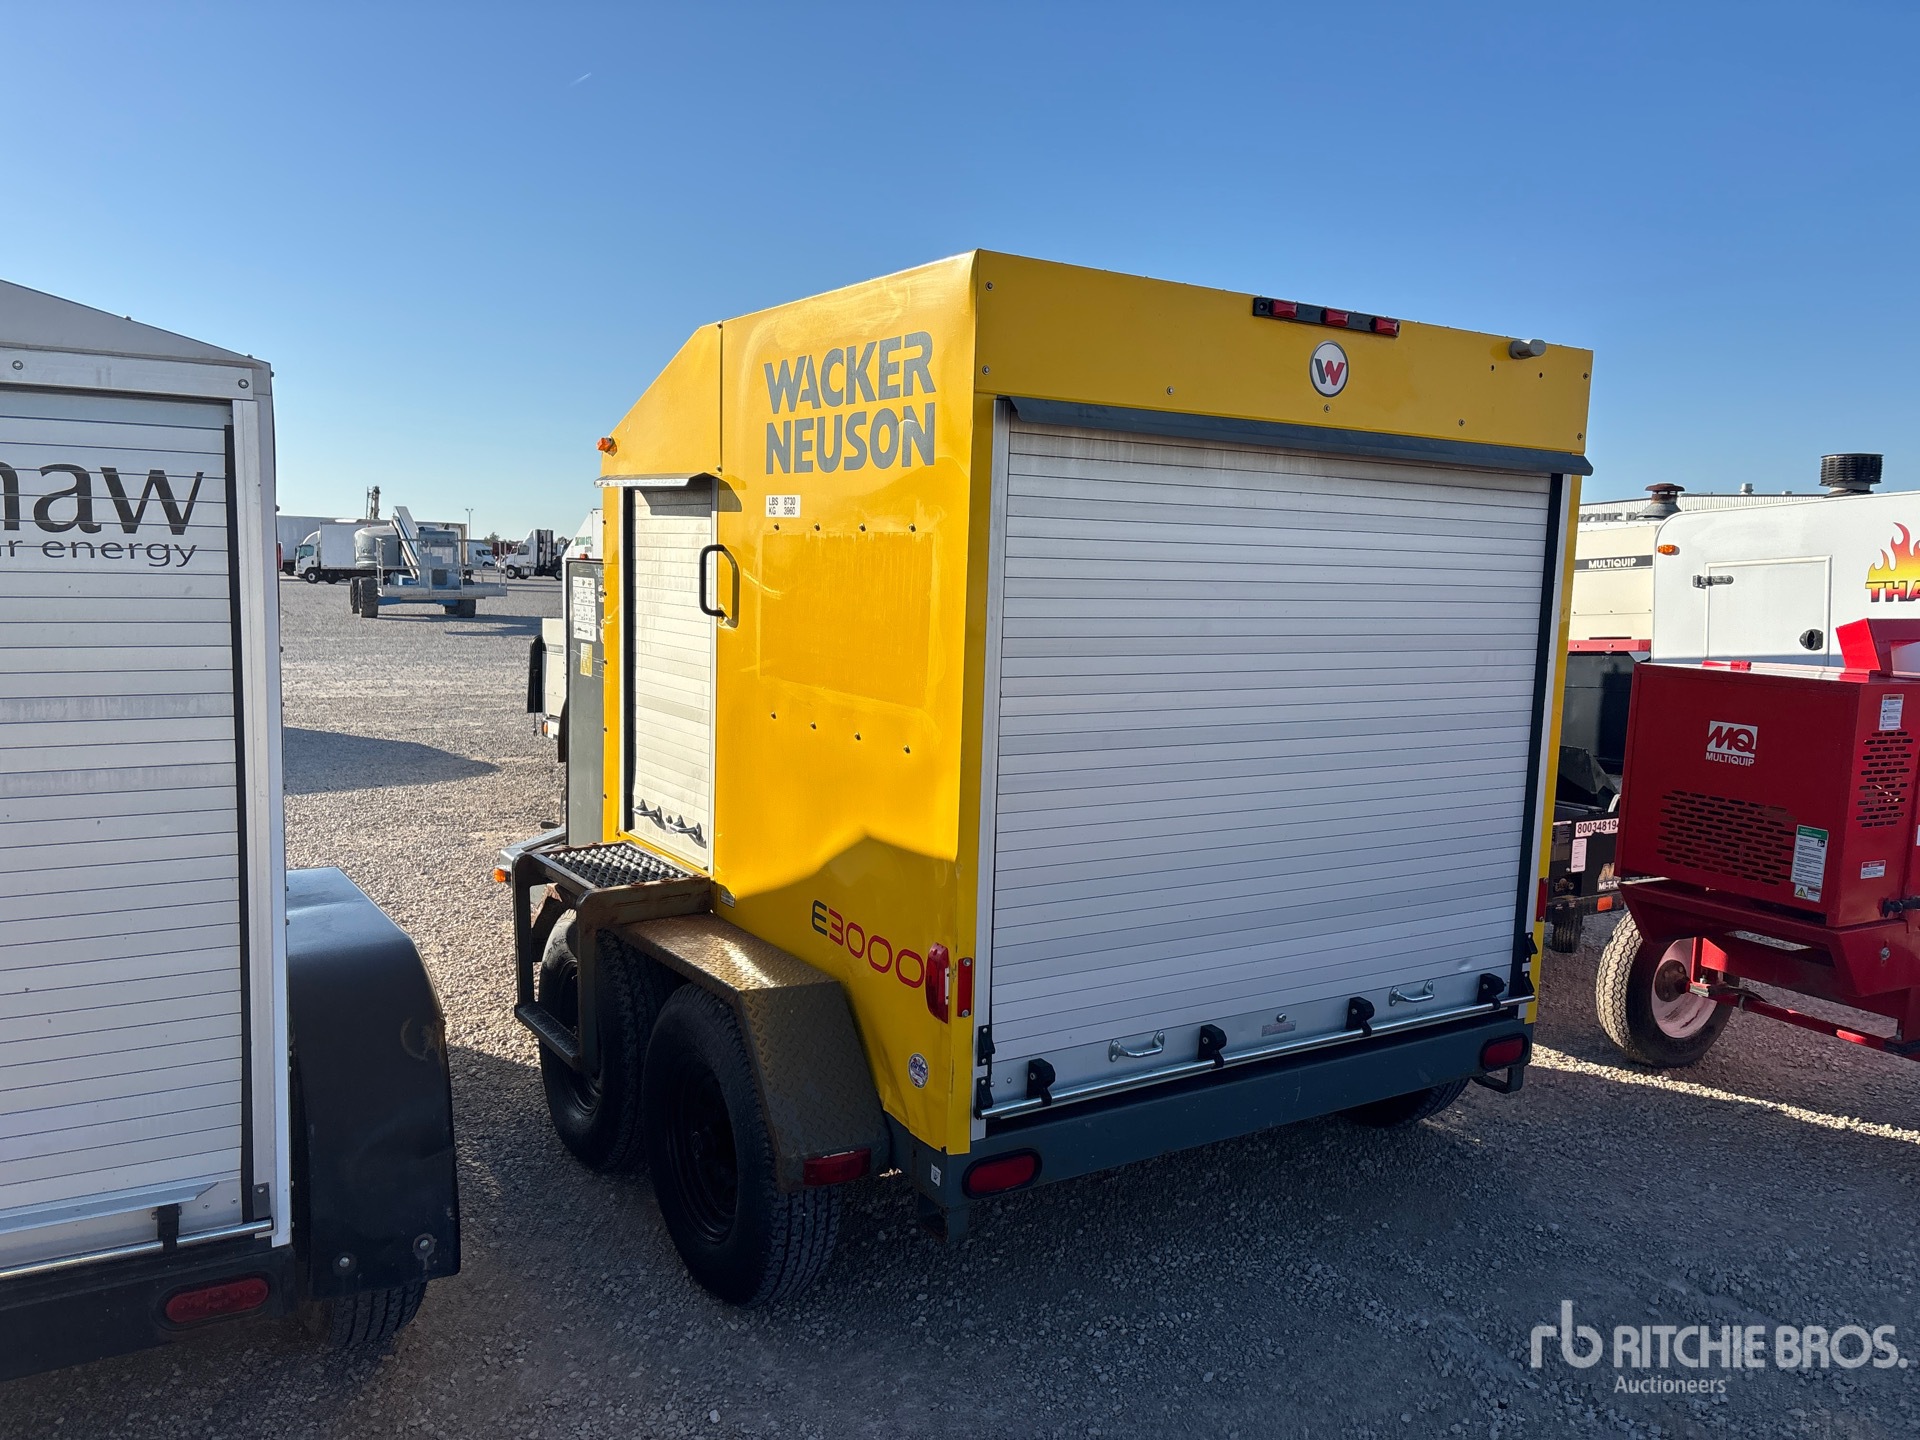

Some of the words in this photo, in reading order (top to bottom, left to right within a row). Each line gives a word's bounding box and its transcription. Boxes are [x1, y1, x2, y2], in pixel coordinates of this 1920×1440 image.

[763, 331, 937, 415] WACKER
[765, 402, 936, 475] NEUSON
[768, 496, 779, 506] LBS
[768, 506, 777, 515] KG
[42, 540, 197, 567] energy
[1588, 557, 1637, 569] MULTIQUIP
[1707, 724, 1757, 754] MQ
[1705, 751, 1755, 767] MULTIQUIP
[1577, 819, 1619, 834] 80034819
[811, 899, 925, 989] E3000
